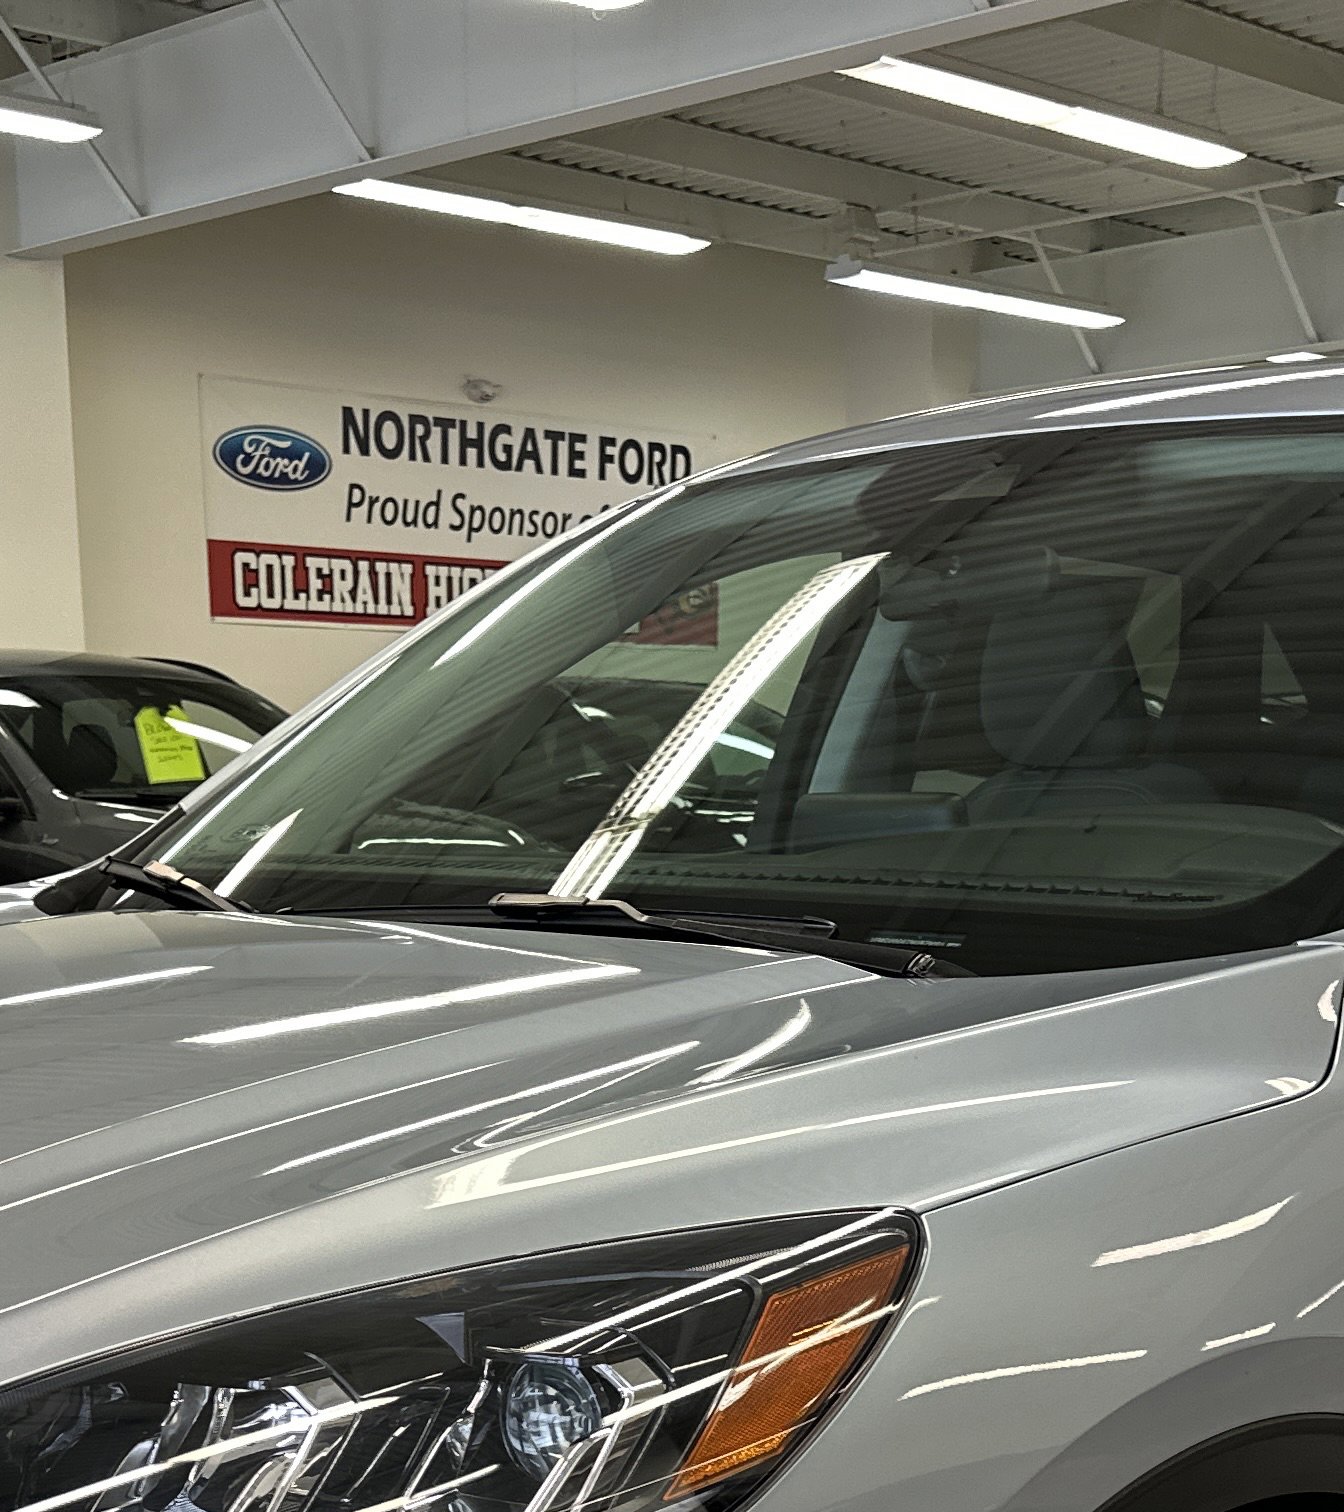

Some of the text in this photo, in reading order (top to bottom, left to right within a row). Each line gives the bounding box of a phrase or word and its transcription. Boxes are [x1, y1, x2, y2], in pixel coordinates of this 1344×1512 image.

[236, 434, 311, 481] Ford
[341, 405, 692, 487] NORTHGATE FORD
[345, 483, 443, 530] Proud
[448, 492, 573, 543] Sponsor
[233, 551, 497, 617] COLERAIN HI
